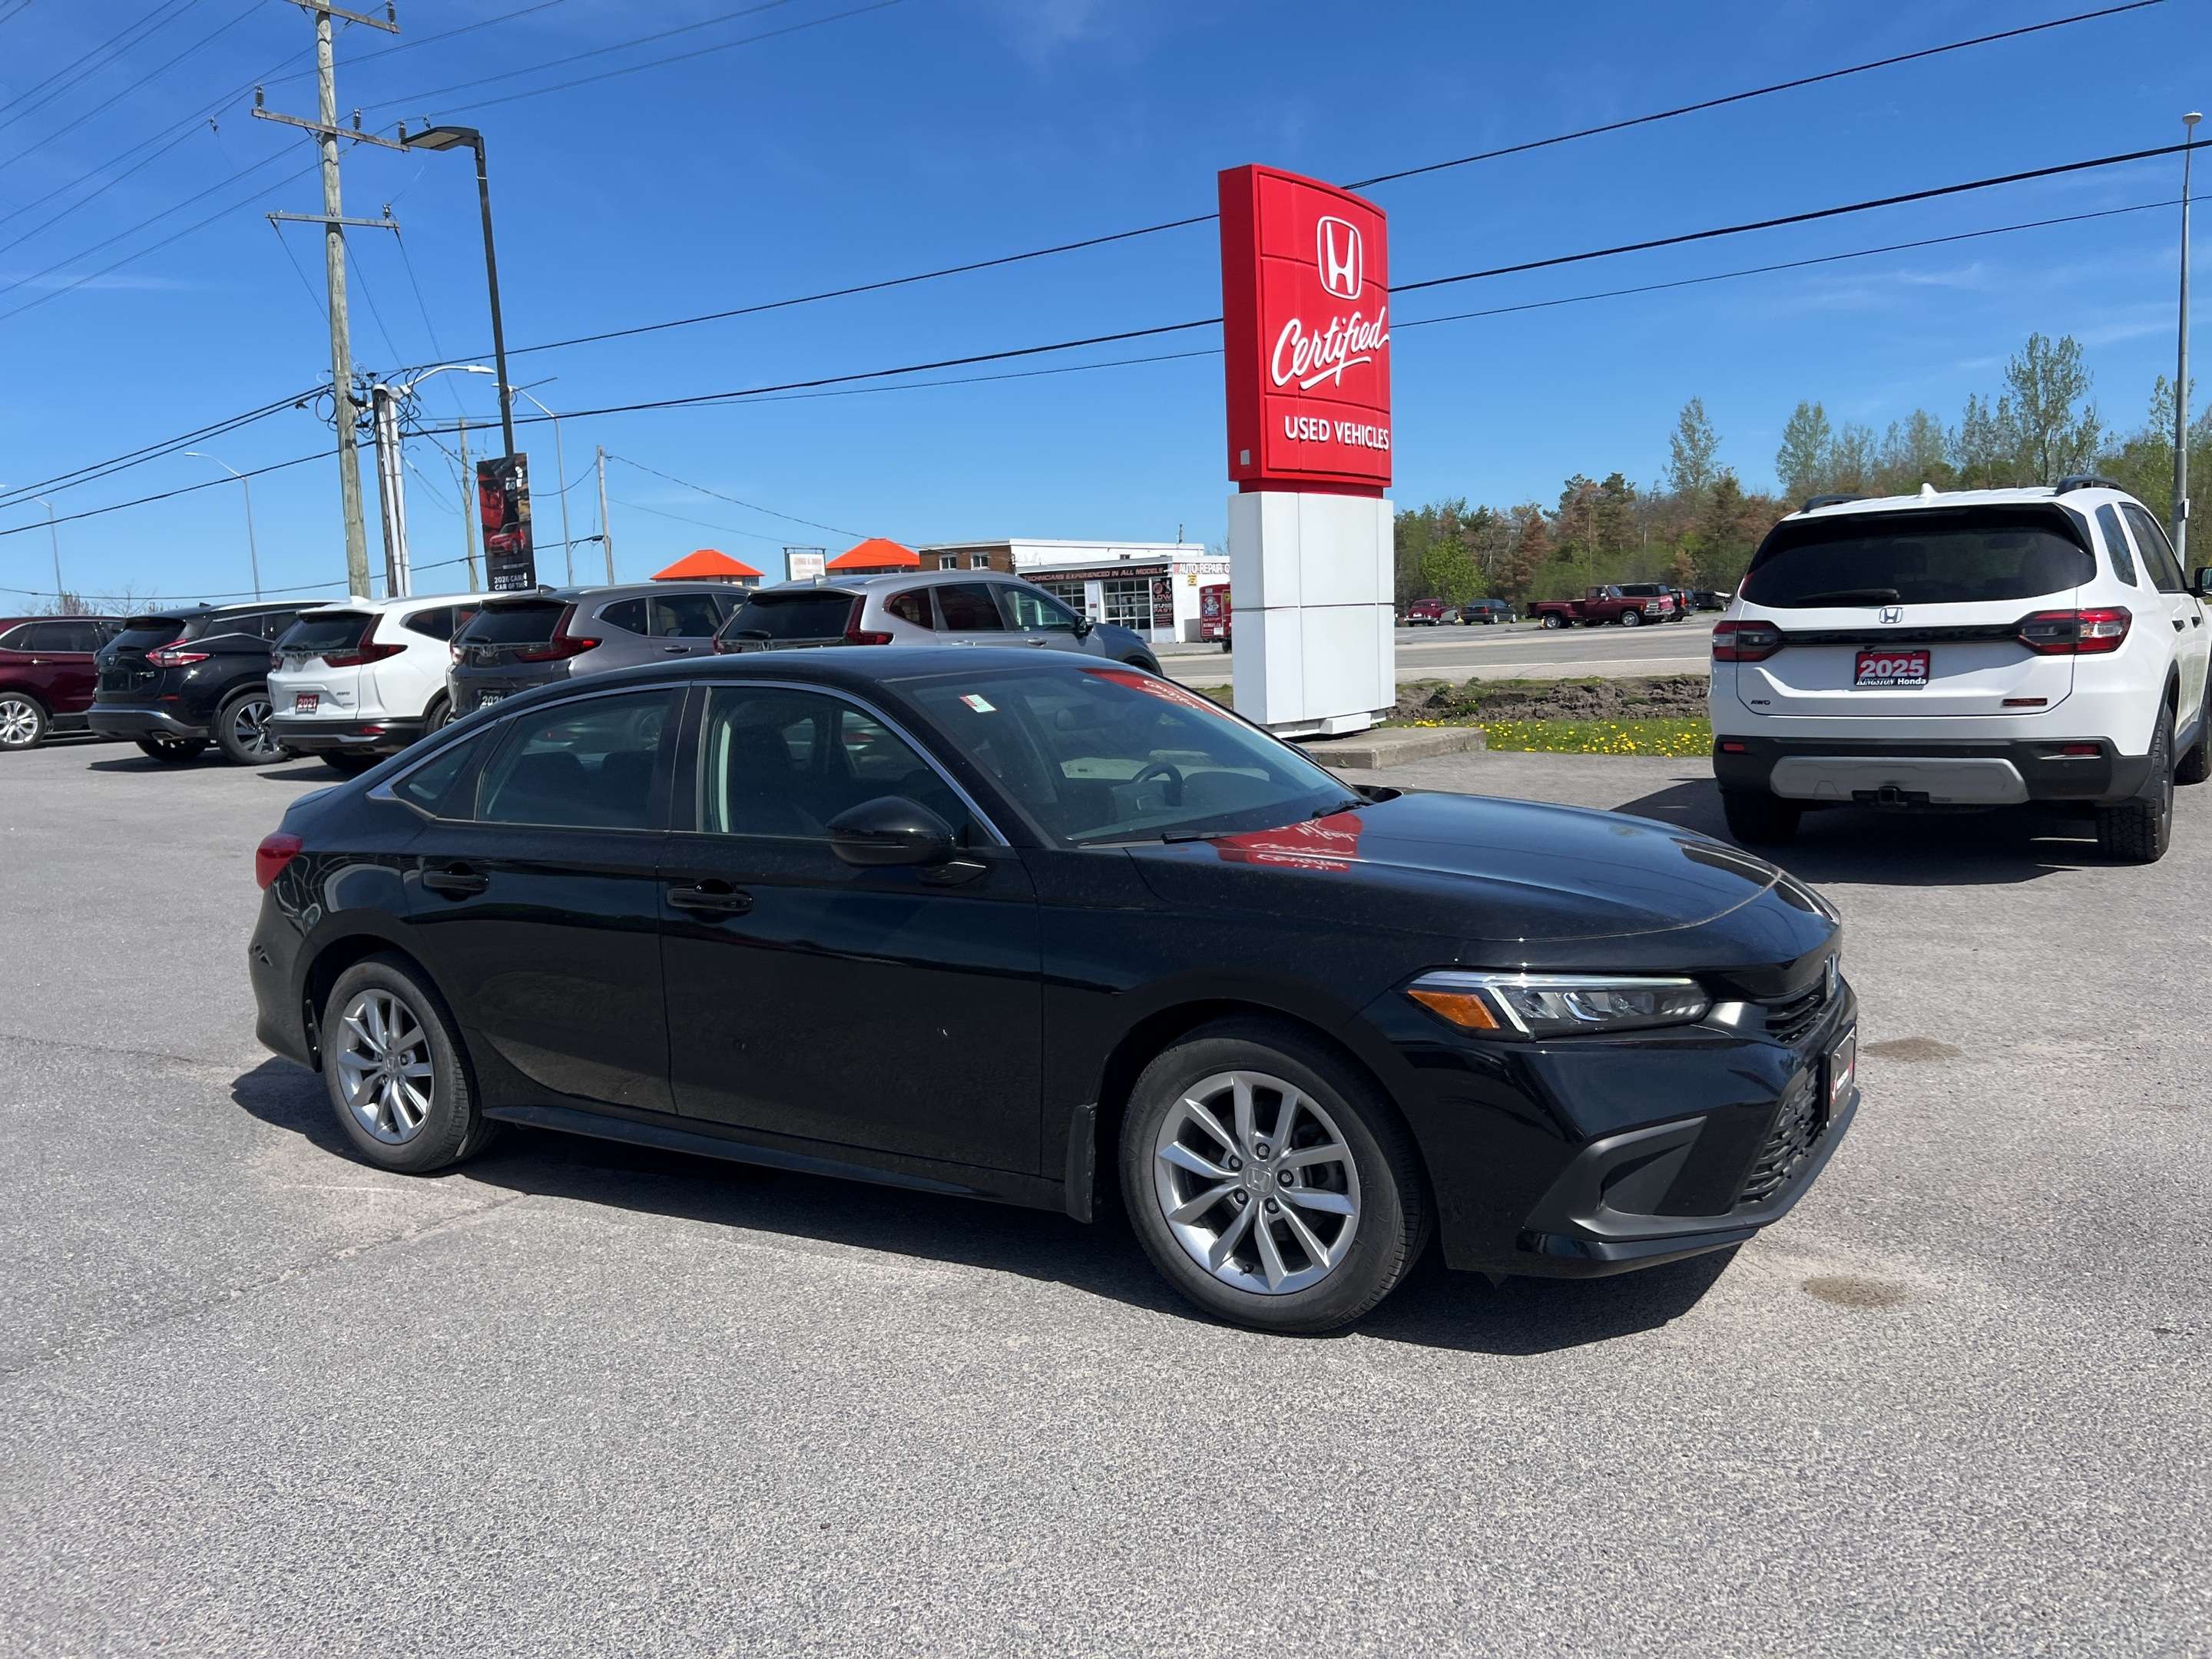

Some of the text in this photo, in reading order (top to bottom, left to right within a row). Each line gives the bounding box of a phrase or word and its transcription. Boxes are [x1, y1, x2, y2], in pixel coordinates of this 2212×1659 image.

[1271, 306, 1389, 390] Certified
[1284, 416, 1389, 451] USED VEHICLES
[1065, 571, 1110, 580] EXPERIENCED
[1135, 567, 1163, 575] MODELS
[1180, 563, 1197, 575] AUTO
[1199, 563, 1221, 575] REPAIR
[1859, 659, 1926, 677] 2025
[1856, 677, 1895, 686] KINGSTON
[297, 697, 316, 708] 2021
